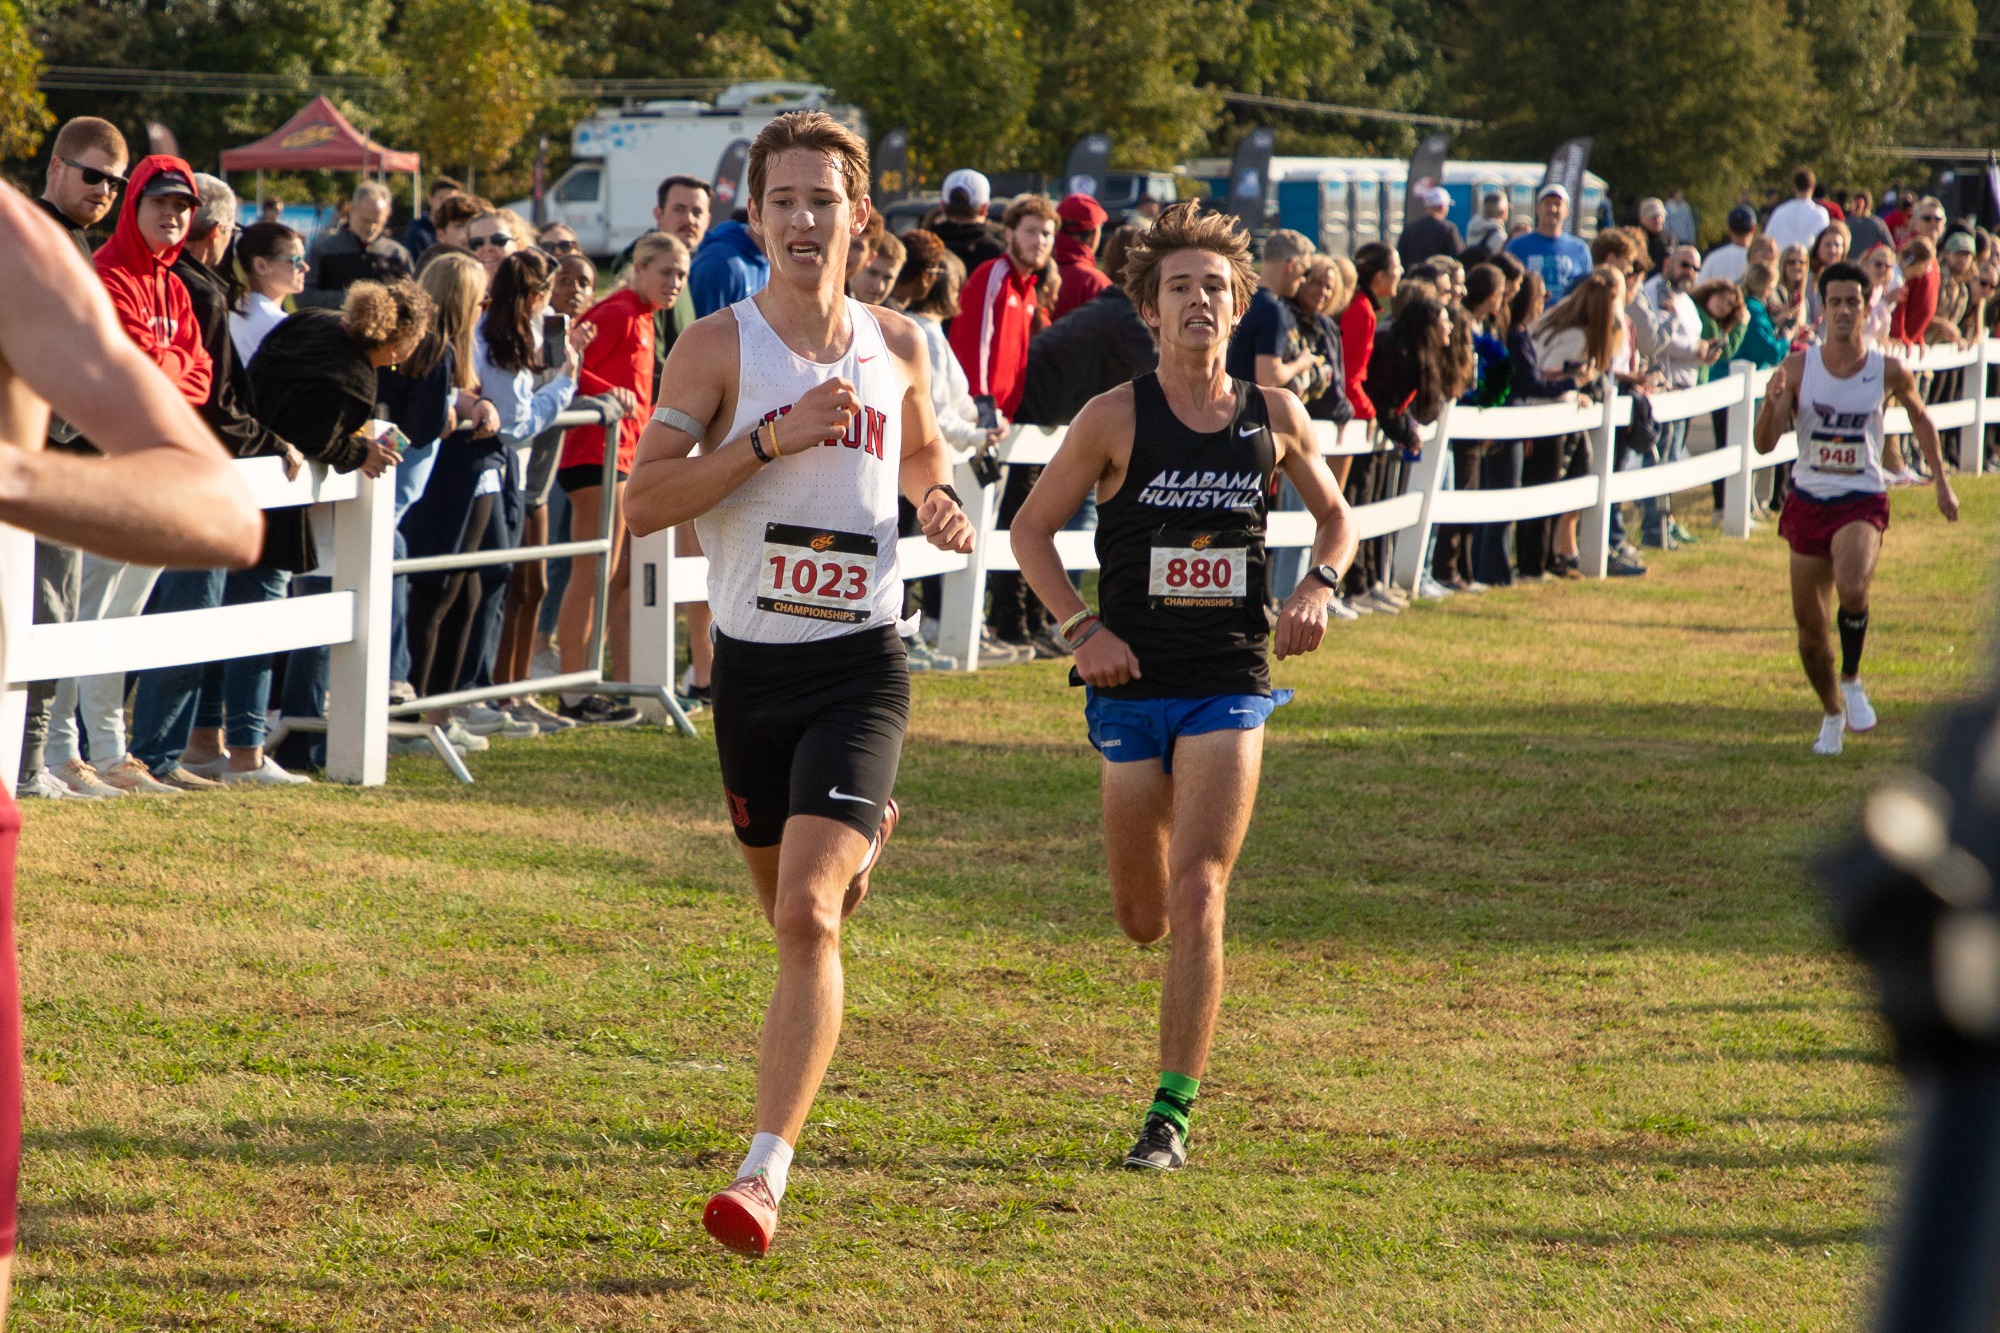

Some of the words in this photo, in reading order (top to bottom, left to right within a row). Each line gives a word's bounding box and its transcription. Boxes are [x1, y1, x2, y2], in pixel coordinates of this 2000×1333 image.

[1820, 410, 1870, 429] LEE
[1819, 445, 1856, 465] 948
[1148, 470, 1262, 490] ALABAMA
[1138, 488, 1260, 509] HUNTSVILLE
[769, 555, 868, 600] 1023
[1166, 558, 1232, 588] 880
[773, 601, 856, 621] CHAMPIONSHIPS
[1163, 597, 1234, 607] CHAMPIONSHIPS
